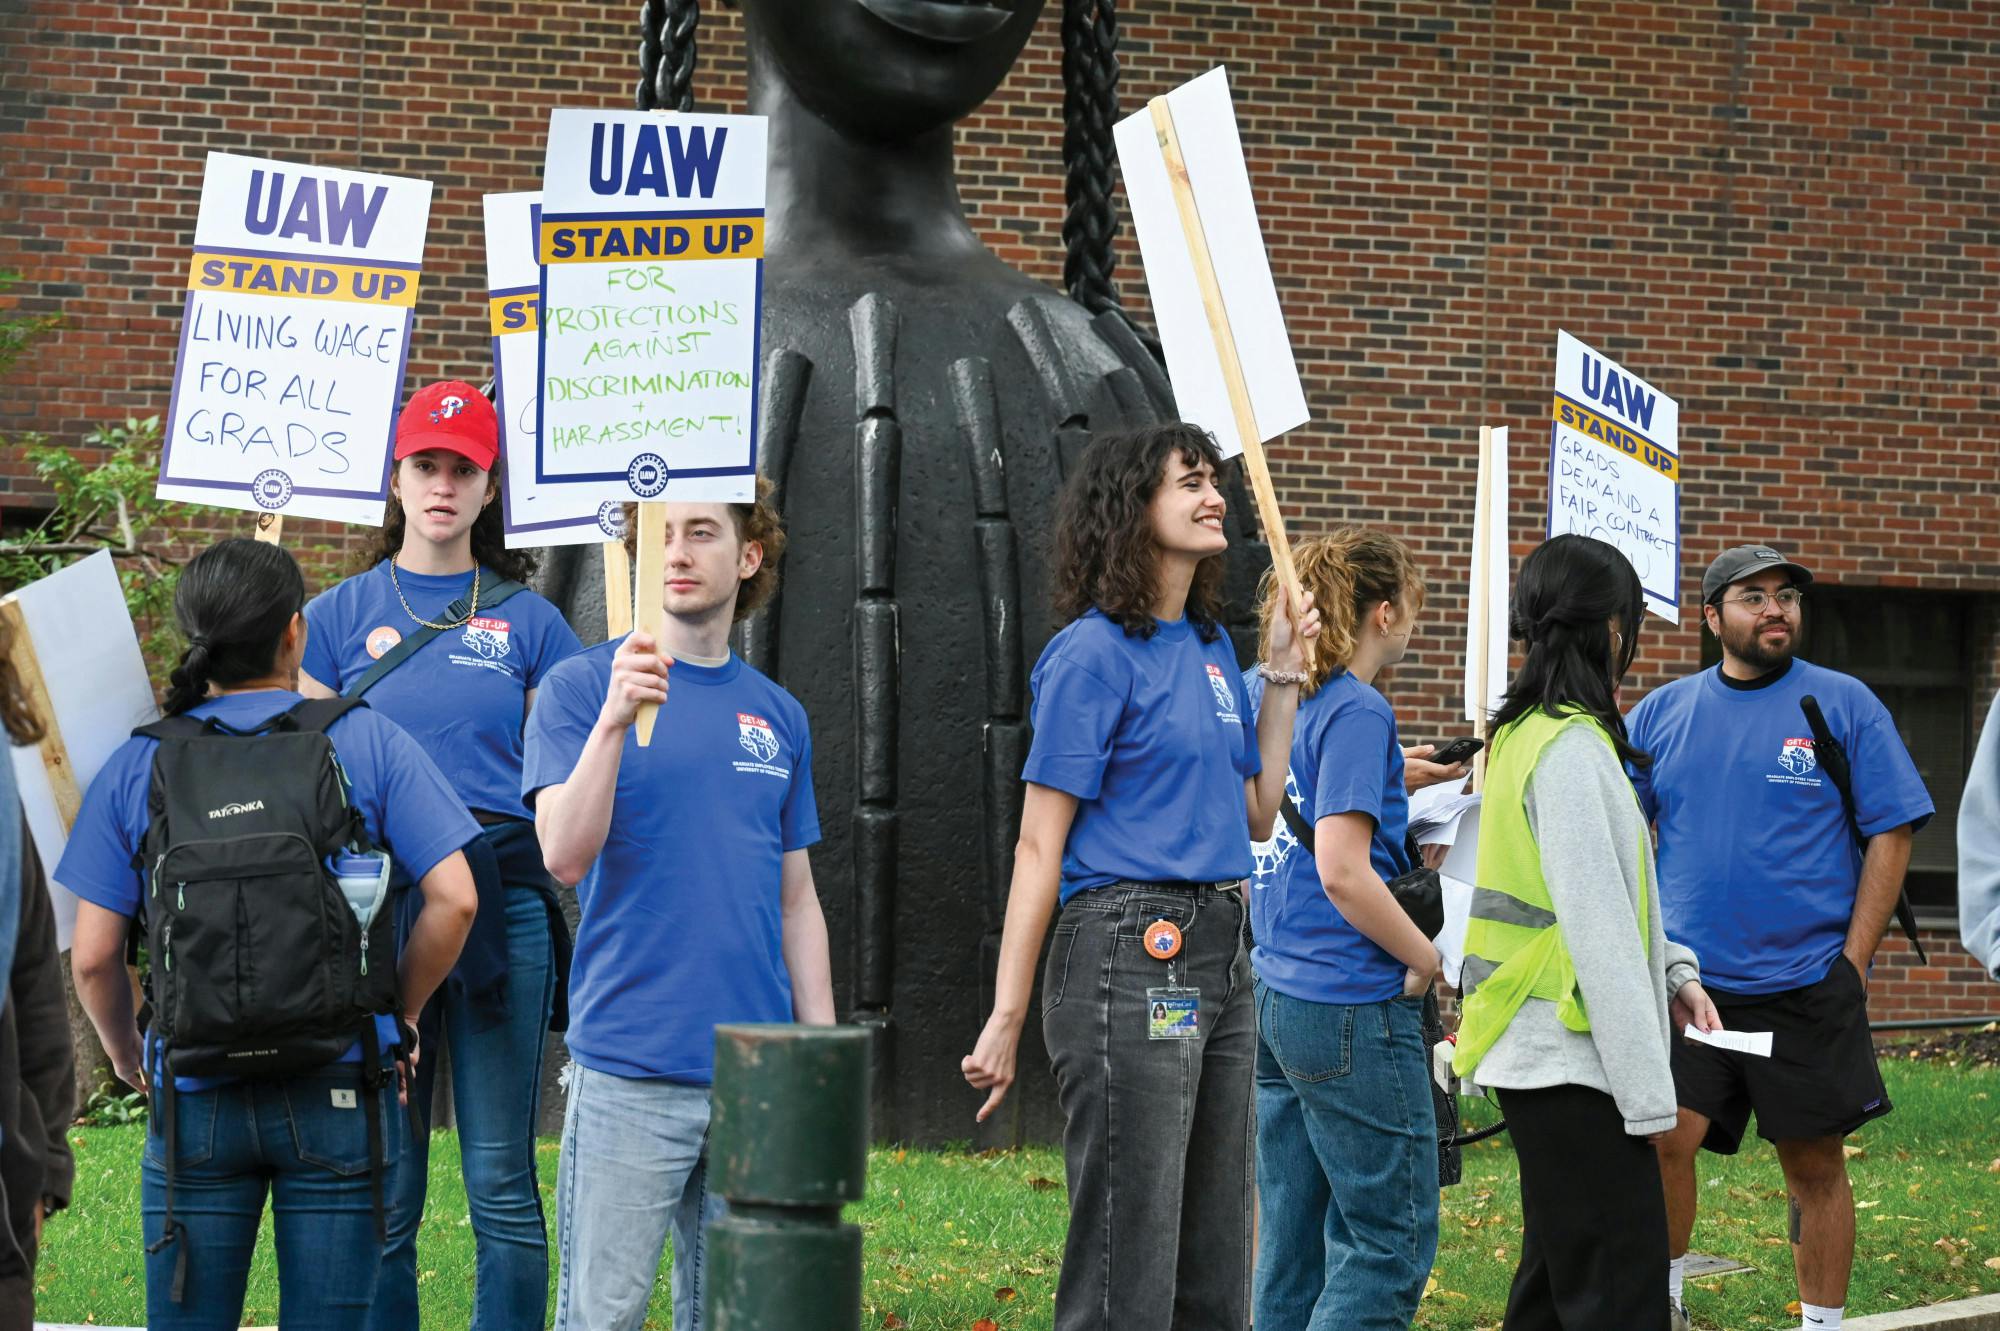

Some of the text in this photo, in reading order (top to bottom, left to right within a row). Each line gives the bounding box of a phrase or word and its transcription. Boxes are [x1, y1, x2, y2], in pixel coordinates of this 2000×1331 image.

[589, 122, 728, 199] UAW
[244, 169, 389, 249] UAW
[551, 227, 690, 258] STAND
[703, 224, 754, 255] UP
[200, 260, 407, 300] STAND UP
[607, 266, 676, 294] FOR
[192, 303, 396, 363] LIVING WAGE
[544, 300, 738, 340] PROTECTIONS
[583, 331, 711, 365] AGAINST
[199, 362, 351, 415] FOR ALL
[548, 371, 751, 402] DISCRIMINATION
[1582, 352, 1656, 431] UAW
[186, 408, 350, 475] GRADS
[553, 416, 742, 453] HARASSMENT!
[1560, 405, 1673, 473] STAND UP
[640, 471, 656, 480] UAW
[1560, 436, 1620, 479] GRADS
[1561, 459, 1661, 526] DEMAND A
[1560, 485, 1677, 558] FAIR CONTRACT
[471, 618, 508, 630] GET-UP
[1786, 739, 1815, 748] GET-U
